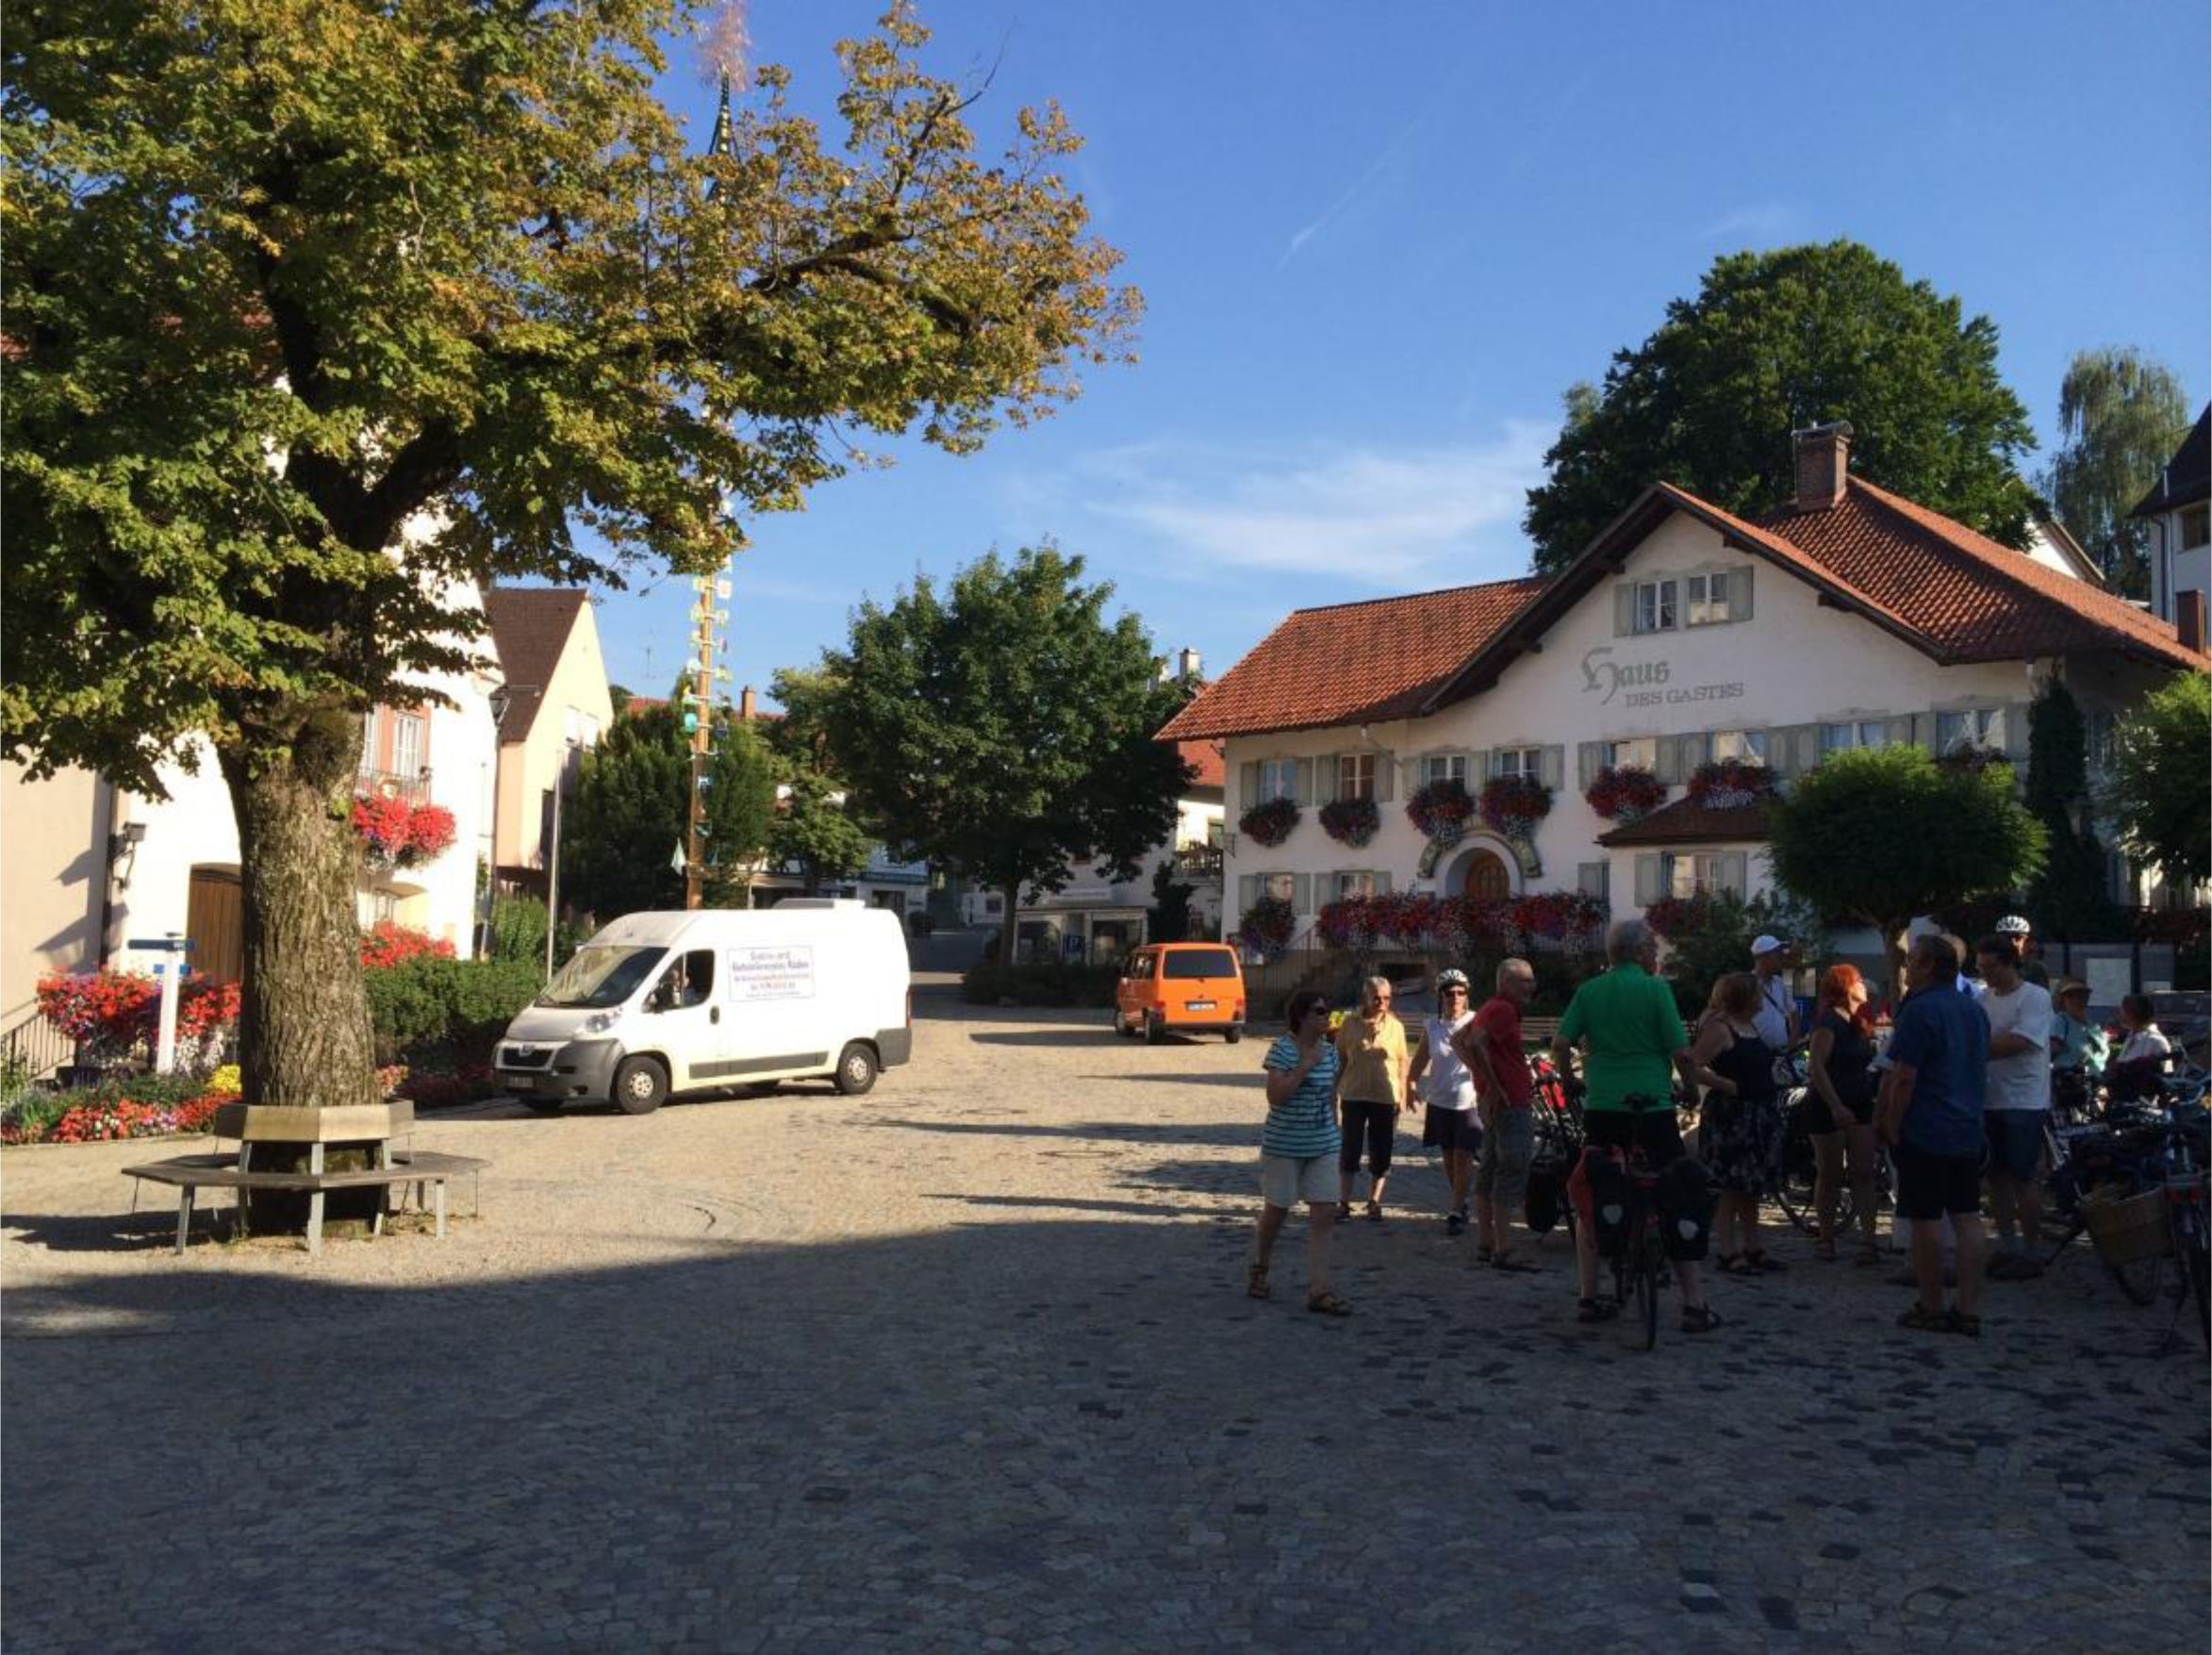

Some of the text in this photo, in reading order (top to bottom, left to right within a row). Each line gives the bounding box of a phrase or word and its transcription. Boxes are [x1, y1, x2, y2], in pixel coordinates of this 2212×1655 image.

[1581, 646, 1670, 705] Haus
[1626, 682, 1744, 708] DES GASTES
